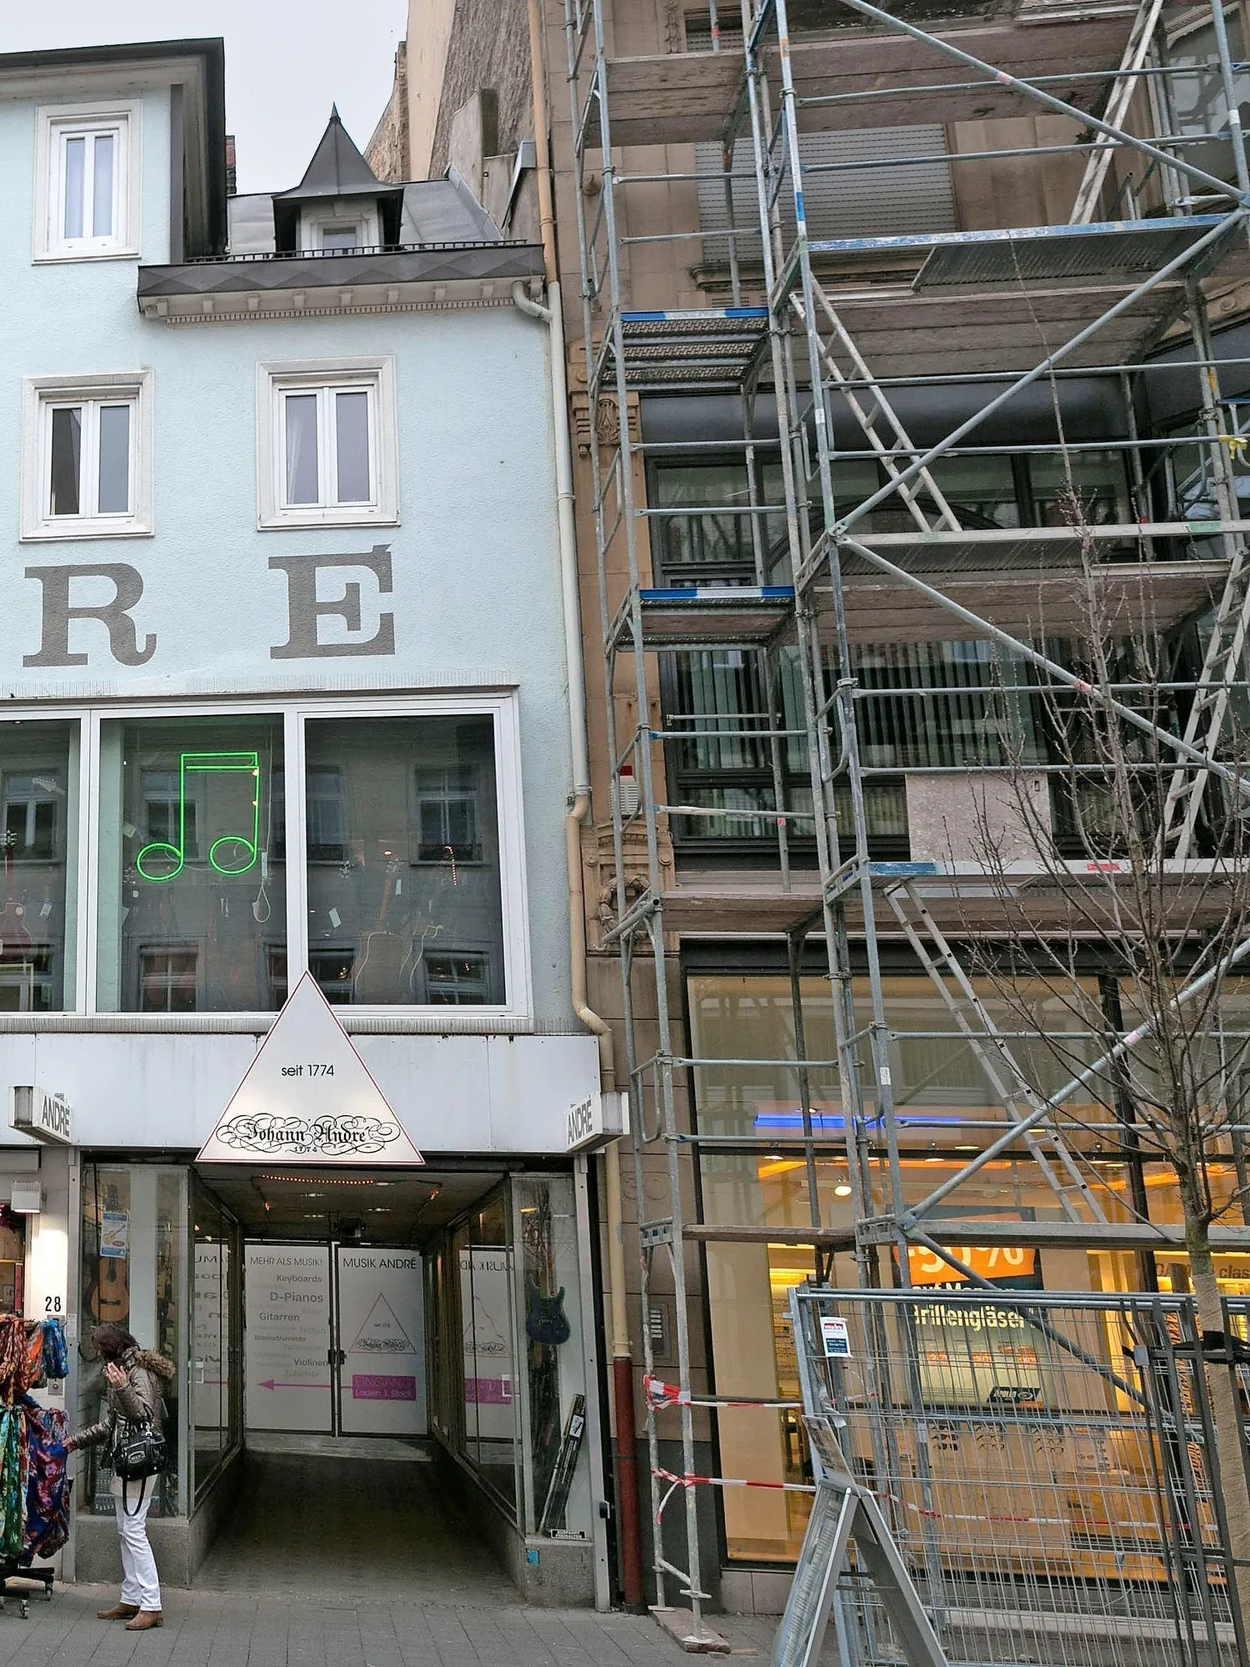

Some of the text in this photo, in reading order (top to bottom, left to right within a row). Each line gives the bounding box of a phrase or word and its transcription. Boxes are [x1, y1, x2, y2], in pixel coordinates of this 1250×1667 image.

[281, 1064, 335, 1077] seit 1774
[250, 1256, 323, 1267] MEHR ALS MUSIK!
[343, 1256, 417, 1269] MUSIK ANDRÉ
[276, 1274, 322, 1284] Keyboards
[270, 1291, 324, 1303] D-Pianos
[45, 1296, 62, 1312] 28
[259, 1312, 300, 1322] Gitarren
[293, 1358, 329, 1367] Violinen
